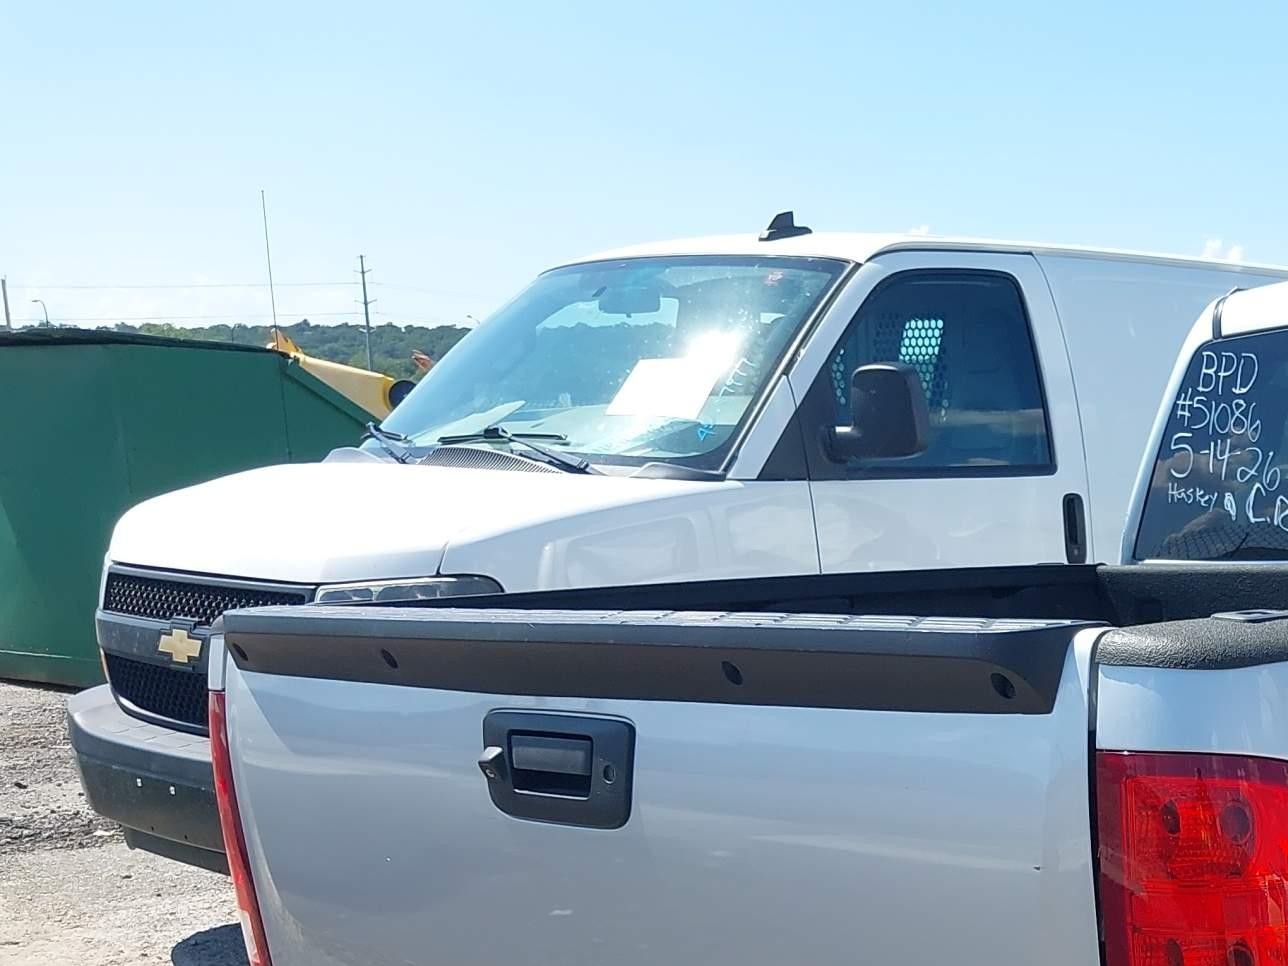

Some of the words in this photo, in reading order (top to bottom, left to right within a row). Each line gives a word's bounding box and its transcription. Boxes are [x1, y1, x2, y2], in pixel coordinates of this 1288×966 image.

[1197, 351, 1258, 395] BPD
[1175, 388, 1262, 442] #51086
[1170, 432, 1281, 491] 5-14-26
